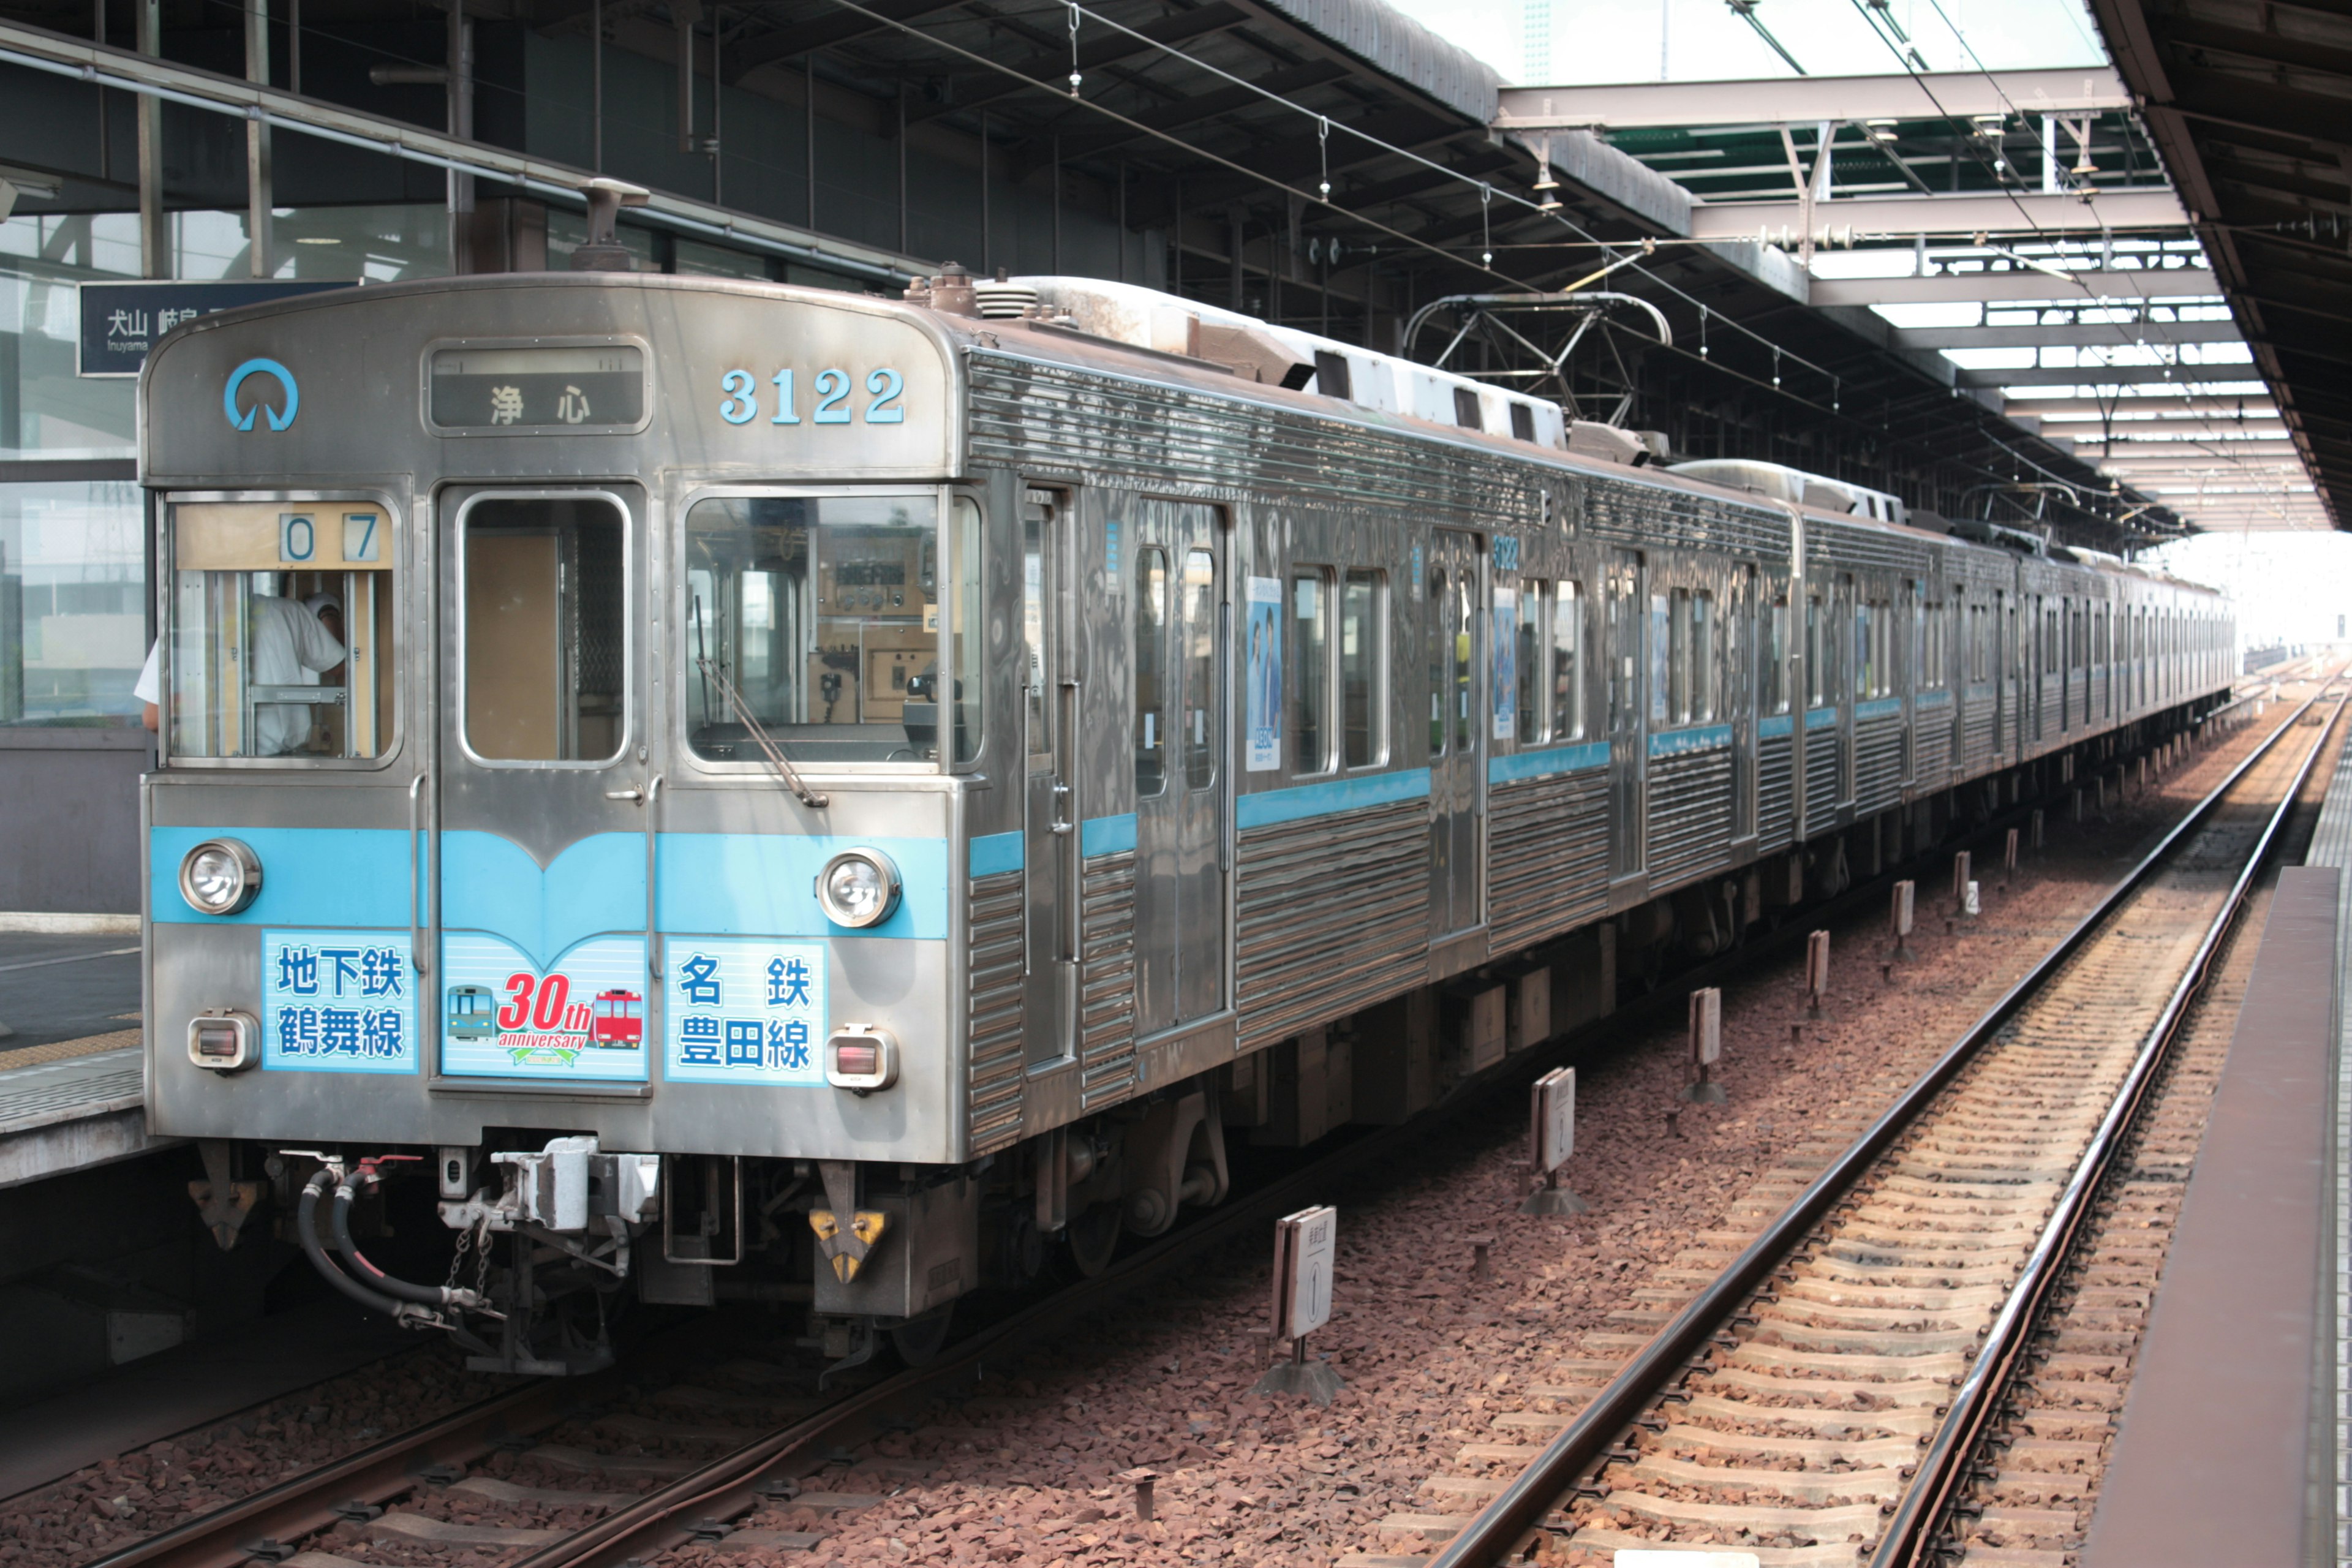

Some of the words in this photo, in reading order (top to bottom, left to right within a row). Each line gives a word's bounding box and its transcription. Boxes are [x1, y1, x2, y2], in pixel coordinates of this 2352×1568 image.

[107, 339, 148, 353] Inuyama
[108, 309, 148, 337] 犬山
[720, 368, 904, 424] 3122
[1255, 727, 1273, 749] AEON
[278, 946, 403, 997] 地下鉄
[497, 973, 593, 1030] 30th
[278, 1006, 403, 1057] 鶴舞線
[498, 1031, 586, 1050] anniversary
[680, 1017, 810, 1069] 豊田線
